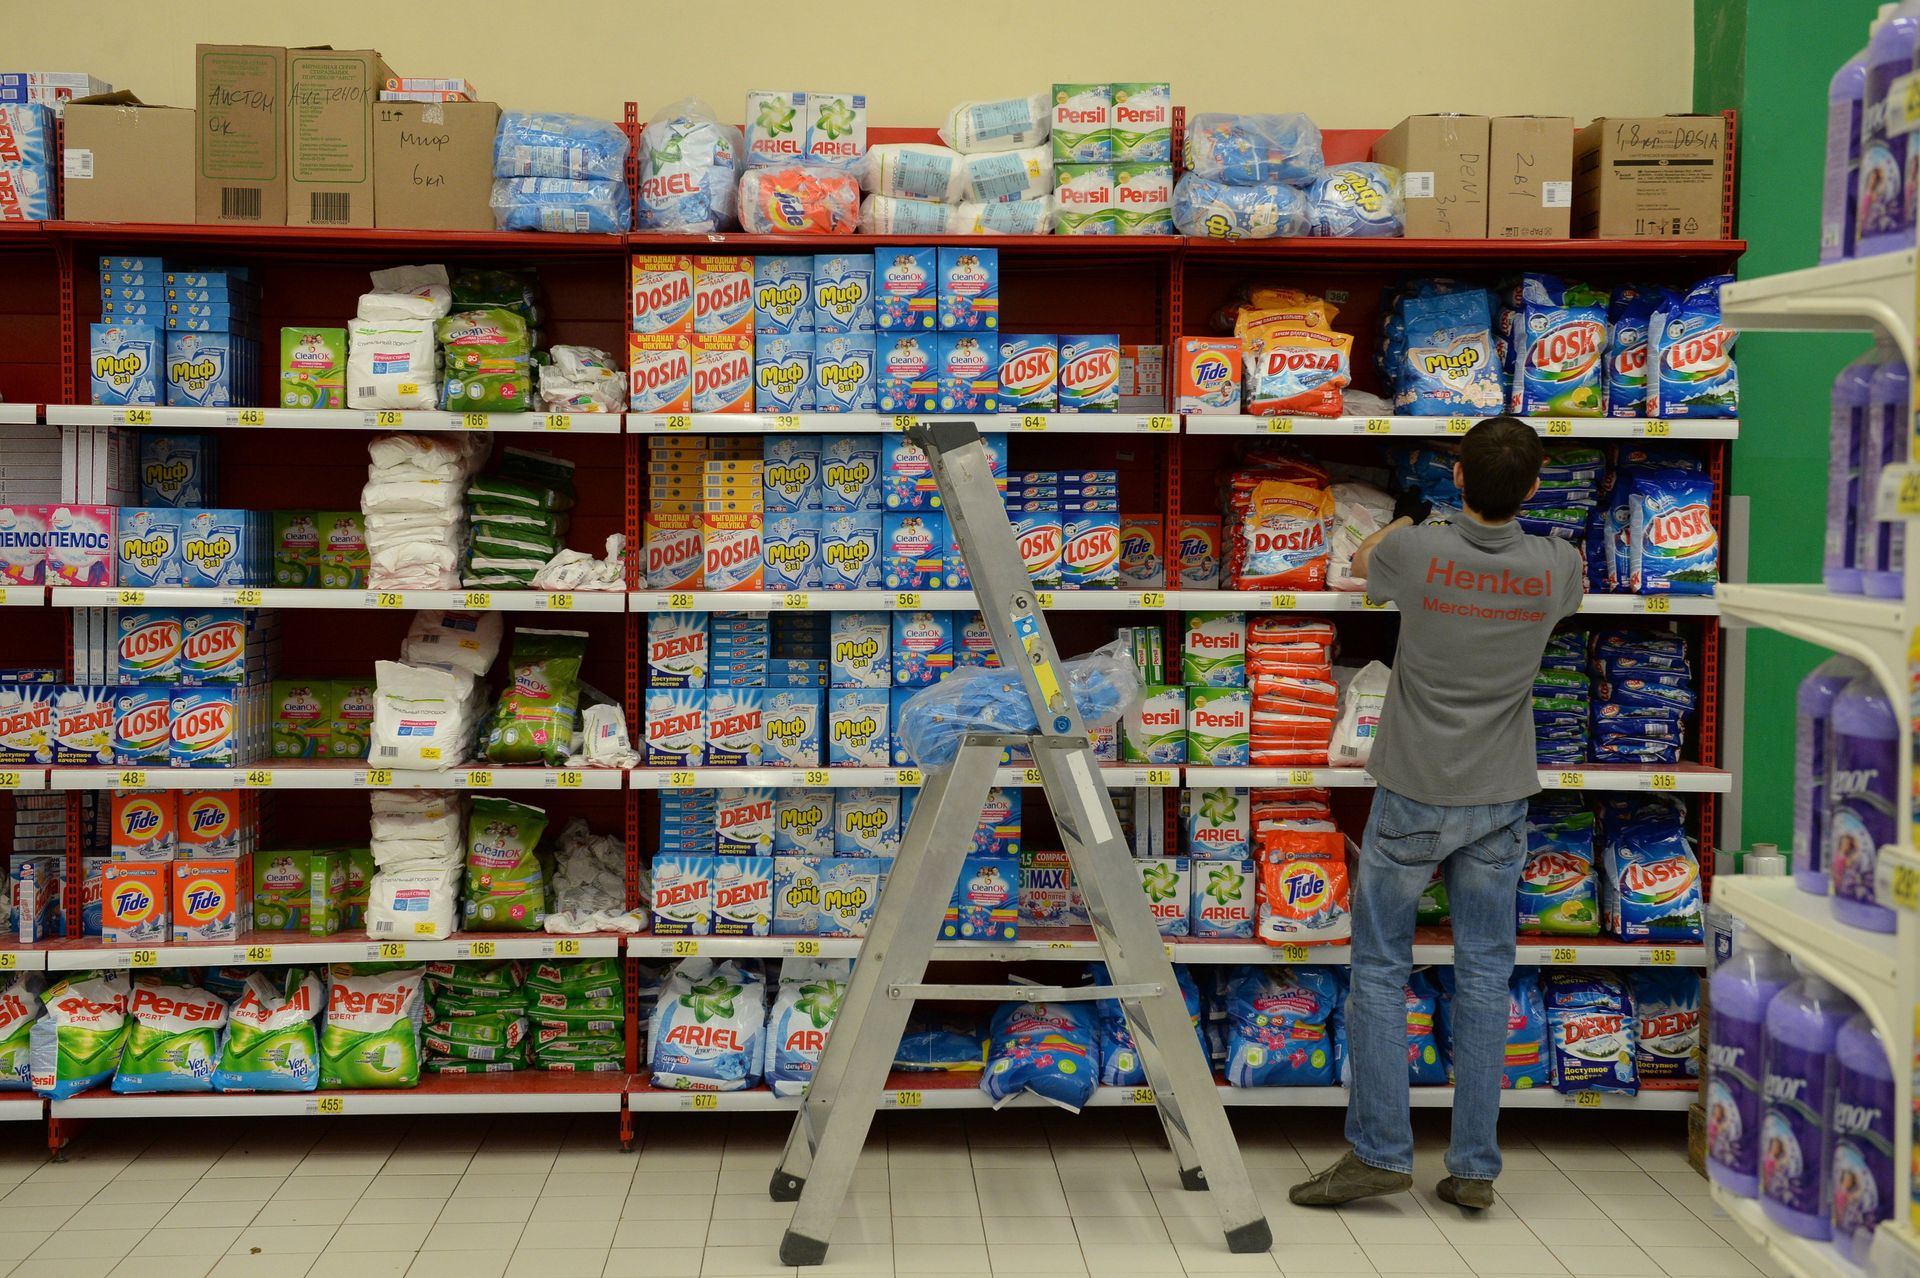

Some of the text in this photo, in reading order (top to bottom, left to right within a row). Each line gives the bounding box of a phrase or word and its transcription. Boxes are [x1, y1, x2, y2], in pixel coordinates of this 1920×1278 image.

[1058, 107, 1105, 123] Persil
[1117, 106, 1164, 123] Persil
[1674, 128, 1717, 150] DOSIA
[752, 140, 801, 154] ARIEL
[811, 141, 861, 156] ARIEL
[1062, 187, 1109, 203] Persil
[1120, 187, 1168, 203] Persil
[888, 273, 922, 281] CleanOK
[952, 273, 985, 281] CleanOK
[635, 278, 690, 317] DOSIA
[697, 279, 751, 317] DOSIA
[1537, 325, 1596, 368] LOSK
[295, 352, 330, 361] CleanOK
[951, 356, 984, 364] CleanOK
[1004, 352, 1050, 388] LOSK
[1064, 352, 1112, 388] LOSK
[1268, 353, 1339, 375] DOSIA
[171, 359, 215, 383] Миф
[633, 356, 688, 395] DOSIA
[695, 357, 749, 395] DOSIA
[762, 364, 803, 387] Миф
[1196, 362, 1228, 385] Tide
[379, 412, 394, 423] 78
[466, 415, 483, 425] 166
[549, 416, 563, 426] 18
[670, 417, 683, 426] 28
[778, 416, 792, 426] 39
[1025, 417, 1039, 427] 64
[1152, 418, 1166, 428] 67
[1271, 419, 1287, 429] 127
[1368, 419, 1382, 430] 87
[1450, 421, 1466, 430] 155
[1550, 422, 1566, 432] 256
[1648, 422, 1664, 432] 315
[147, 462, 187, 483] Миф
[770, 463, 810, 487] Миф
[1654, 506, 1711, 546] LOSK
[48, 532, 109, 548] ПЕМОС
[896, 534, 929, 542] CleanOK
[1255, 523, 1324, 552] DOSIA
[650, 535, 702, 571] DOSIA
[707, 535, 761, 572] DOSIA
[828, 540, 868, 564] Миф
[1068, 532, 1112, 565] LOSK
[1121, 538, 1150, 558] Tide
[1426, 557, 1553, 598] Henkel
[122, 592, 138, 602] 34
[381, 594, 396, 605] 78
[551, 595, 565, 606] 18
[673, 595, 687, 605] 28
[786, 594, 800, 605] 39
[900, 594, 914, 604] 56
[1144, 594, 1158, 604] 67
[1423, 597, 1547, 623] Merchandiser
[906, 630, 939, 638] CleanOK
[1191, 632, 1239, 649] Persil
[124, 627, 173, 660] LOSK
[187, 628, 236, 660] LOSK
[652, 633, 704, 661] DENI
[58, 709, 113, 738] DENI
[122, 706, 169, 739] LOSK
[176, 707, 225, 740] LOSK
[650, 711, 701, 740] DENI
[710, 711, 761, 739] DENI
[1196, 711, 1244, 727] Persil
[836, 716, 876, 741] Миф
[122, 773, 138, 784] 48
[249, 772, 264, 783] 48
[370, 771, 385, 783] 78
[469, 772, 487, 783] 166
[561, 773, 575, 783] 18
[674, 773, 687, 783] 37
[808, 772, 821, 782] 39
[899, 771, 913, 782] 56
[1150, 771, 1163, 782] 81
[1562, 773, 1578, 784] 256
[1654, 775, 1670, 786] 315
[192, 809, 224, 832] Tide
[720, 801, 772, 829] DENI
[126, 810, 159, 834] Tide
[1194, 829, 1245, 842] ARIEL
[474, 843, 522, 858] CleanOK
[1628, 860, 1685, 890] LOSK
[656, 880, 708, 908] DENI
[972, 883, 1005, 892] CleanOK
[1285, 874, 1325, 905] Tide
[716, 881, 769, 908] DENI
[1030, 891, 1047, 900] 100
[116, 892, 150, 917] Tide
[188, 891, 221, 916] Tide
[1201, 907, 1250, 920] ARIEL
[249, 948, 264, 958] 48
[383, 944, 397, 955] 78
[473, 943, 490, 954] 166
[558, 941, 572, 952] 18
[676, 941, 690, 952] 37
[798, 941, 812, 953] 39
[134, 951, 149, 962] 50
[1287, 948, 1302, 959] 190
[1555, 950, 1571, 960] 256
[1655, 951, 1671, 961] 315
[132, 990, 223, 1022] Persil
[329, 984, 413, 1015] Persil
[1563, 1015, 1622, 1044] DENI
[666, 1025, 744, 1050] ARIEL
[695, 1094, 712, 1106] 677
[900, 1093, 916, 1104] 371
[1136, 1089, 1153, 1100] 543
[1579, 1093, 1595, 1105] 257
[321, 1099, 339, 1110] 455
